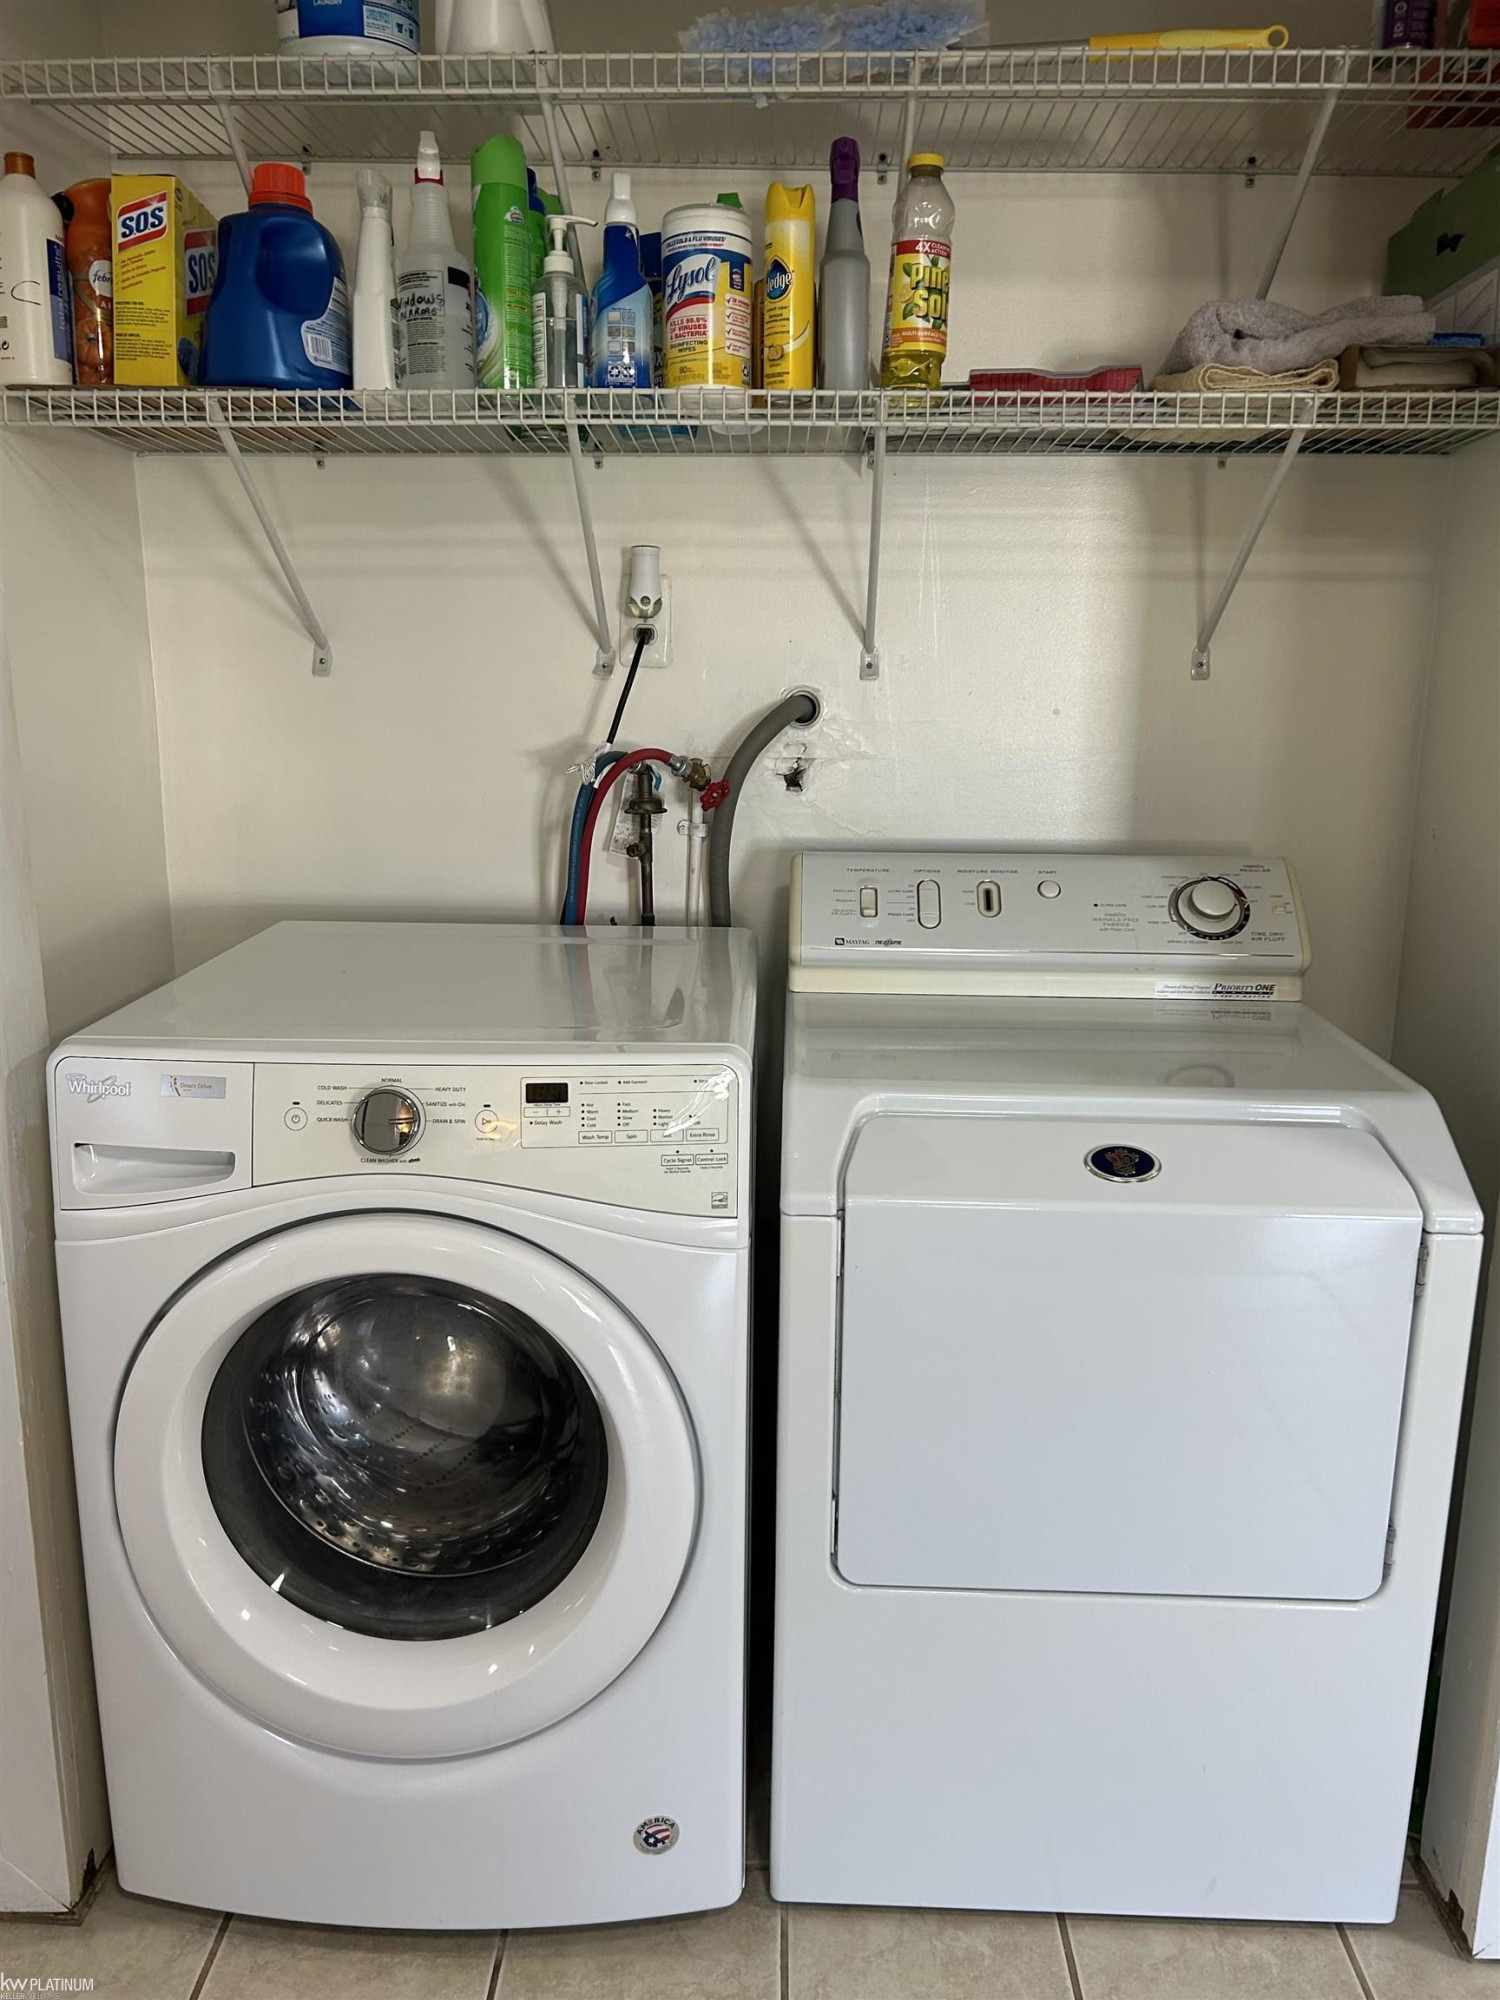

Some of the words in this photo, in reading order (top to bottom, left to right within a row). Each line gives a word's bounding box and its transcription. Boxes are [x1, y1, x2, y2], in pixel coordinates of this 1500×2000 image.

[915, 241, 932, 253] 4X
[666, 256, 716, 305] Lysol
[767, 272, 793, 292] ledge
[910, 263, 950, 292] Pine
[670, 318, 685, 327] KILLS
[678, 323, 708, 331] VIRUSES
[670, 340, 708, 349] DISINFECTING
[68, 1079, 131, 1099] Whirlpool
[637, 1816, 676, 1836] AMERICA
